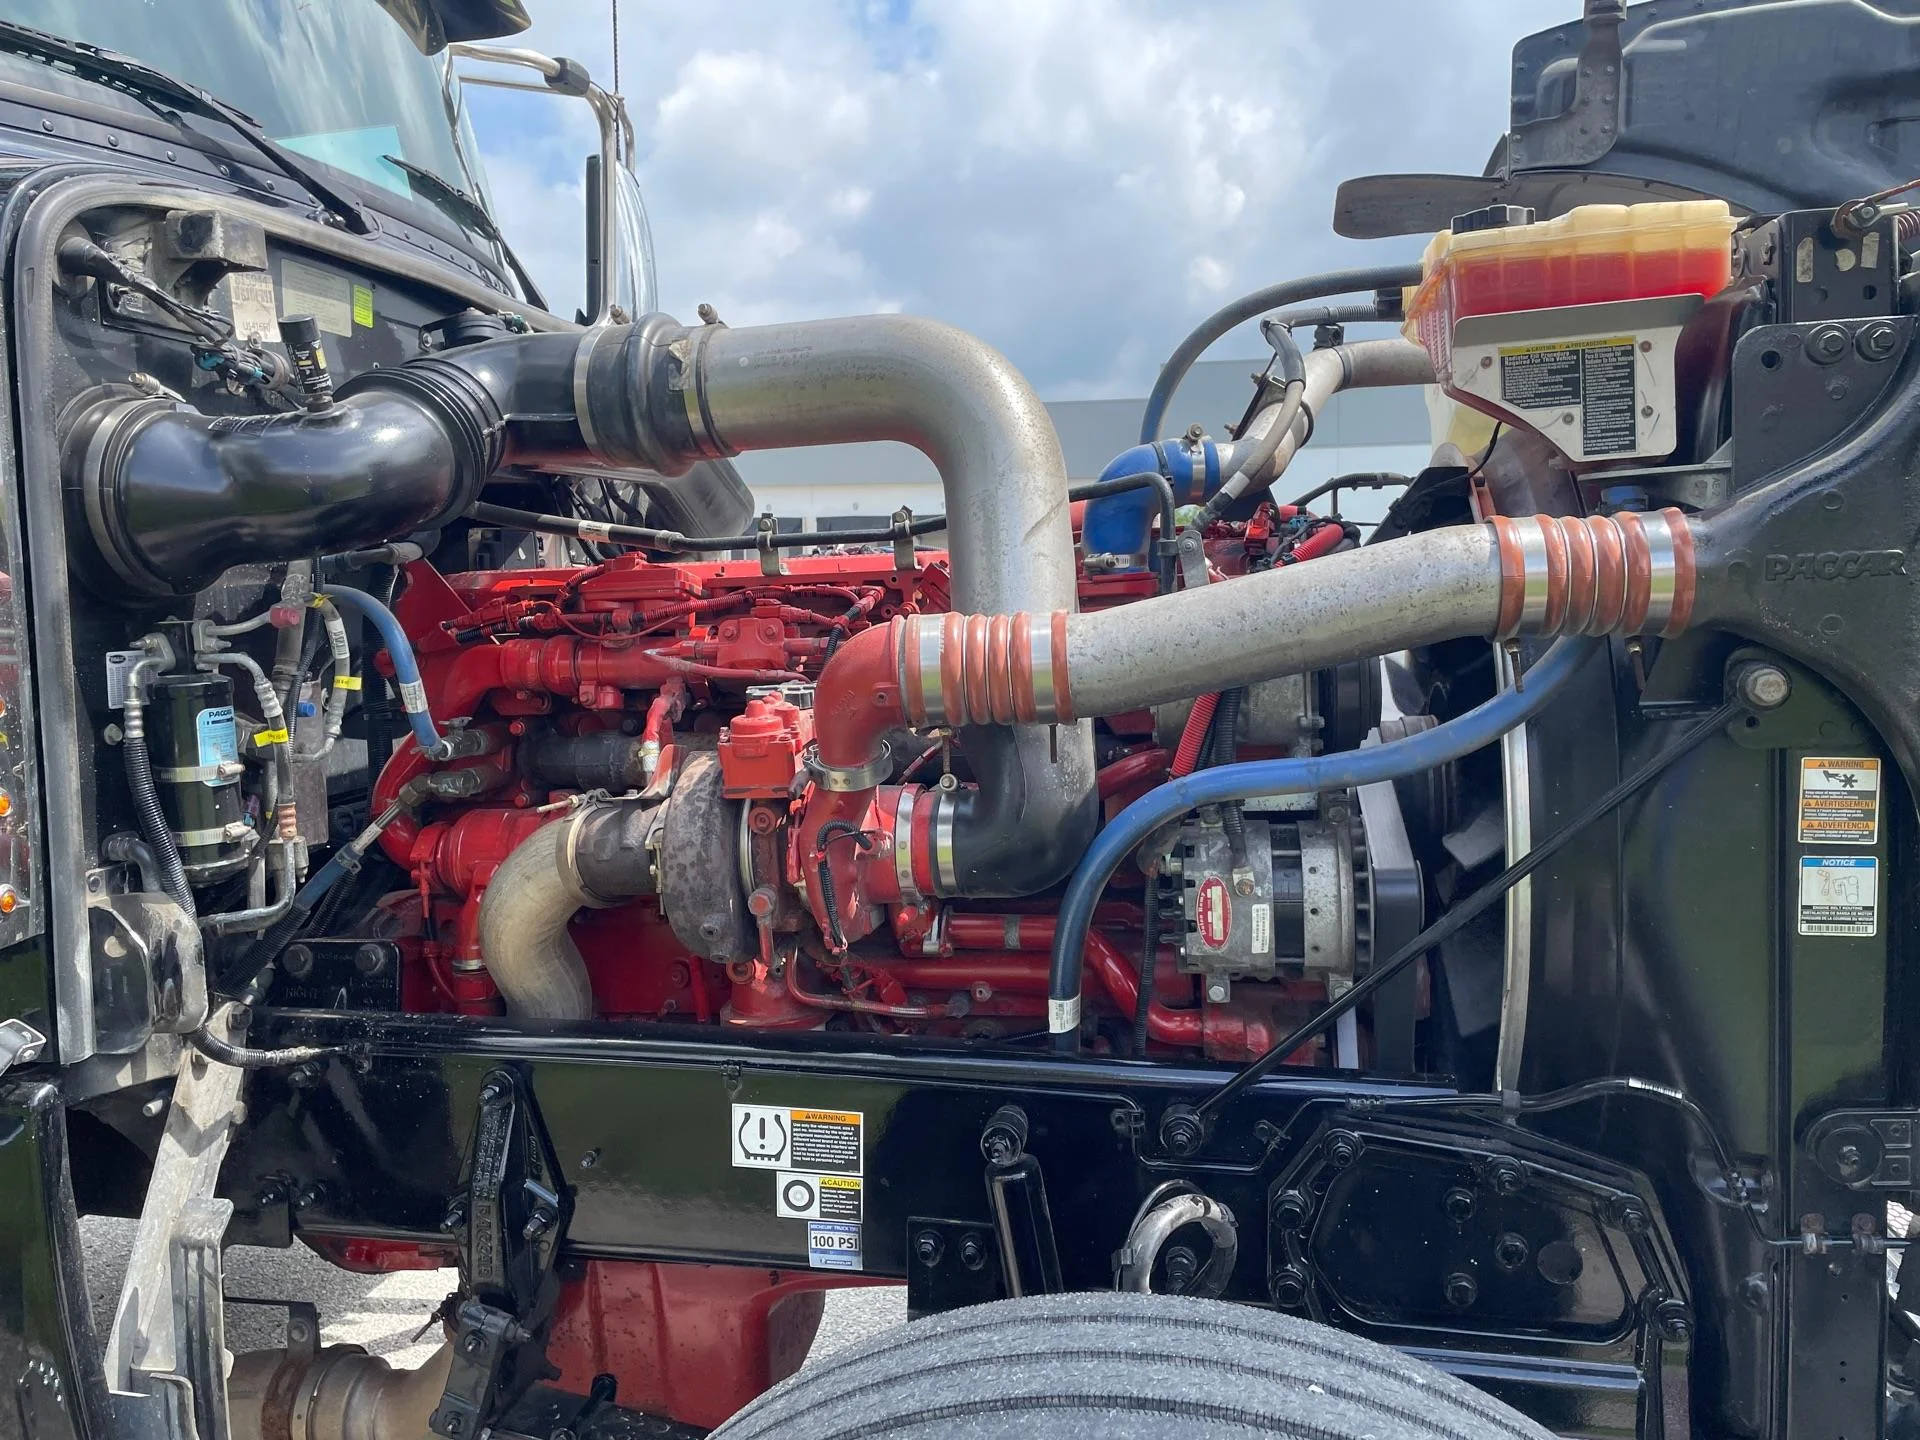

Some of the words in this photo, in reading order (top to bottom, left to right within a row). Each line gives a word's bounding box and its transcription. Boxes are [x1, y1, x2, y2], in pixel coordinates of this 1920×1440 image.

[1764, 550, 1906, 581] PACCAR
[1828, 760, 1864, 768] WARNING
[1815, 800, 1874, 808] AVERTISSEMENT
[811, 1113, 846, 1121] WARNING
[827, 1179, 860, 1188] CAUTION
[813, 1235, 834, 1247] 100
[839, 1237, 857, 1249] PSI
